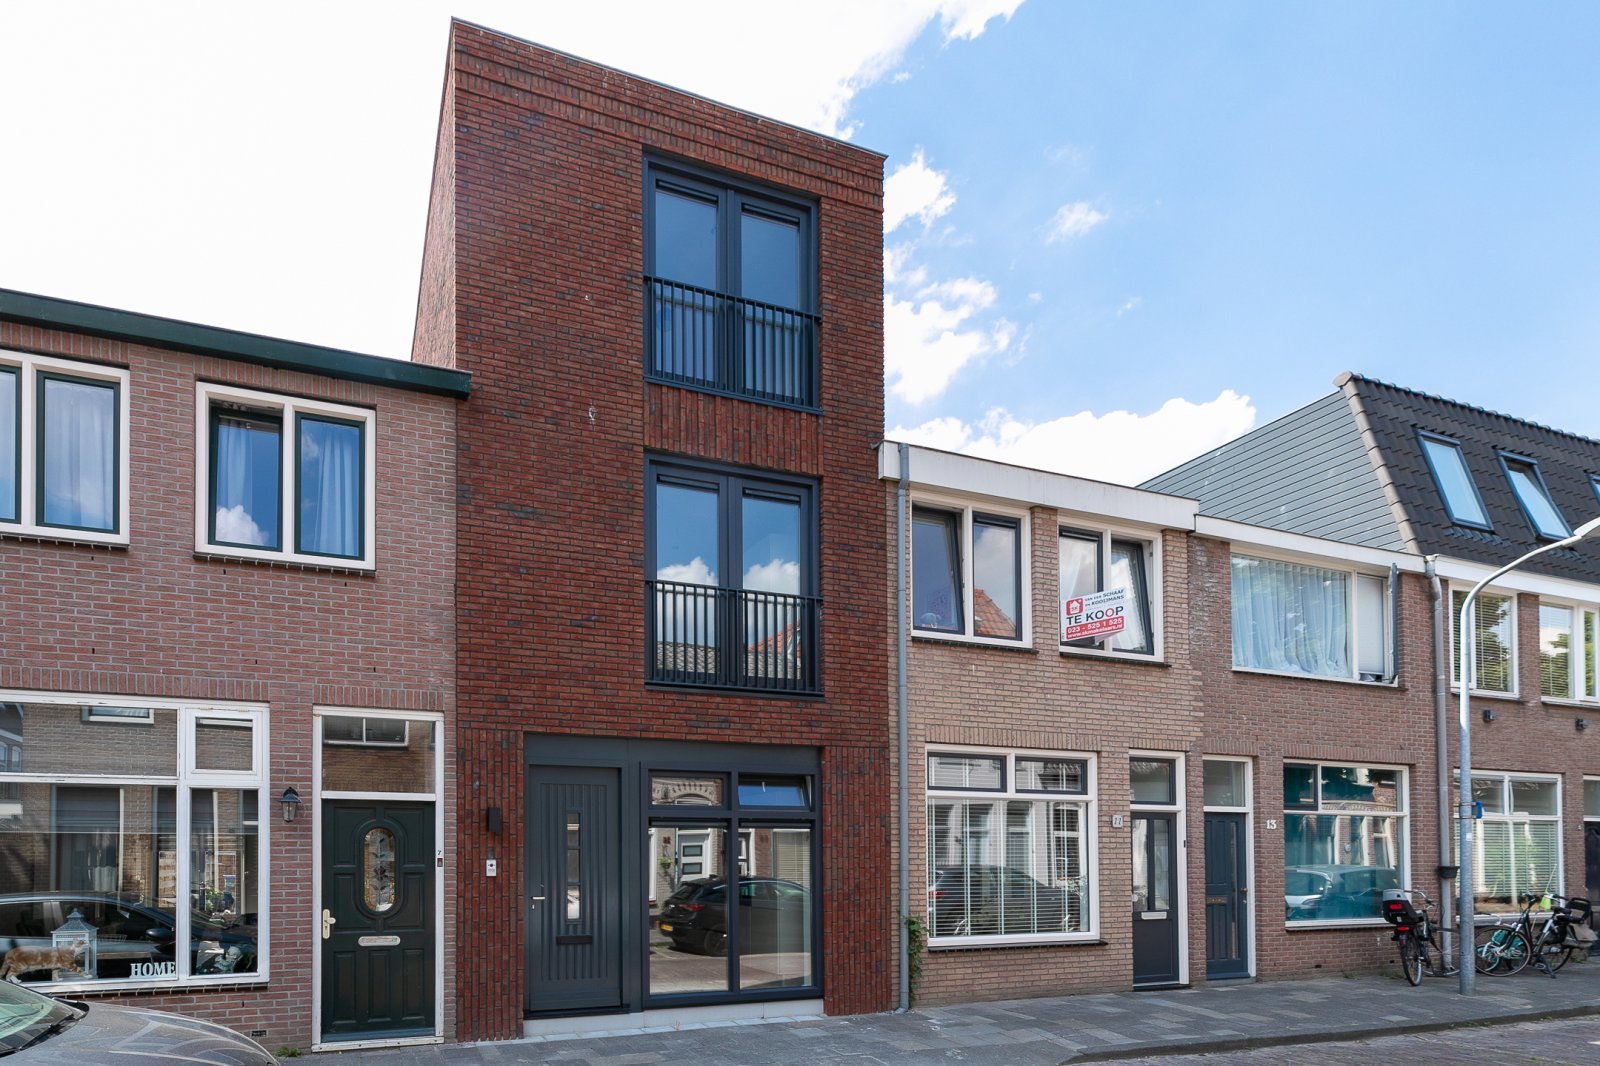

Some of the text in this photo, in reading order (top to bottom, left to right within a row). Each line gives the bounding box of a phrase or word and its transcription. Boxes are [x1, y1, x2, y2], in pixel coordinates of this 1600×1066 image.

[1103, 589, 1124, 597] SCHAAF
[1066, 615, 1082, 625] TE
[1086, 606, 1124, 621] KOOP
[1067, 626, 1080, 634] 023
[1108, 617, 1122, 626] 525
[1266, 819, 1277, 830] 13
[130, 961, 176, 977] HOME
